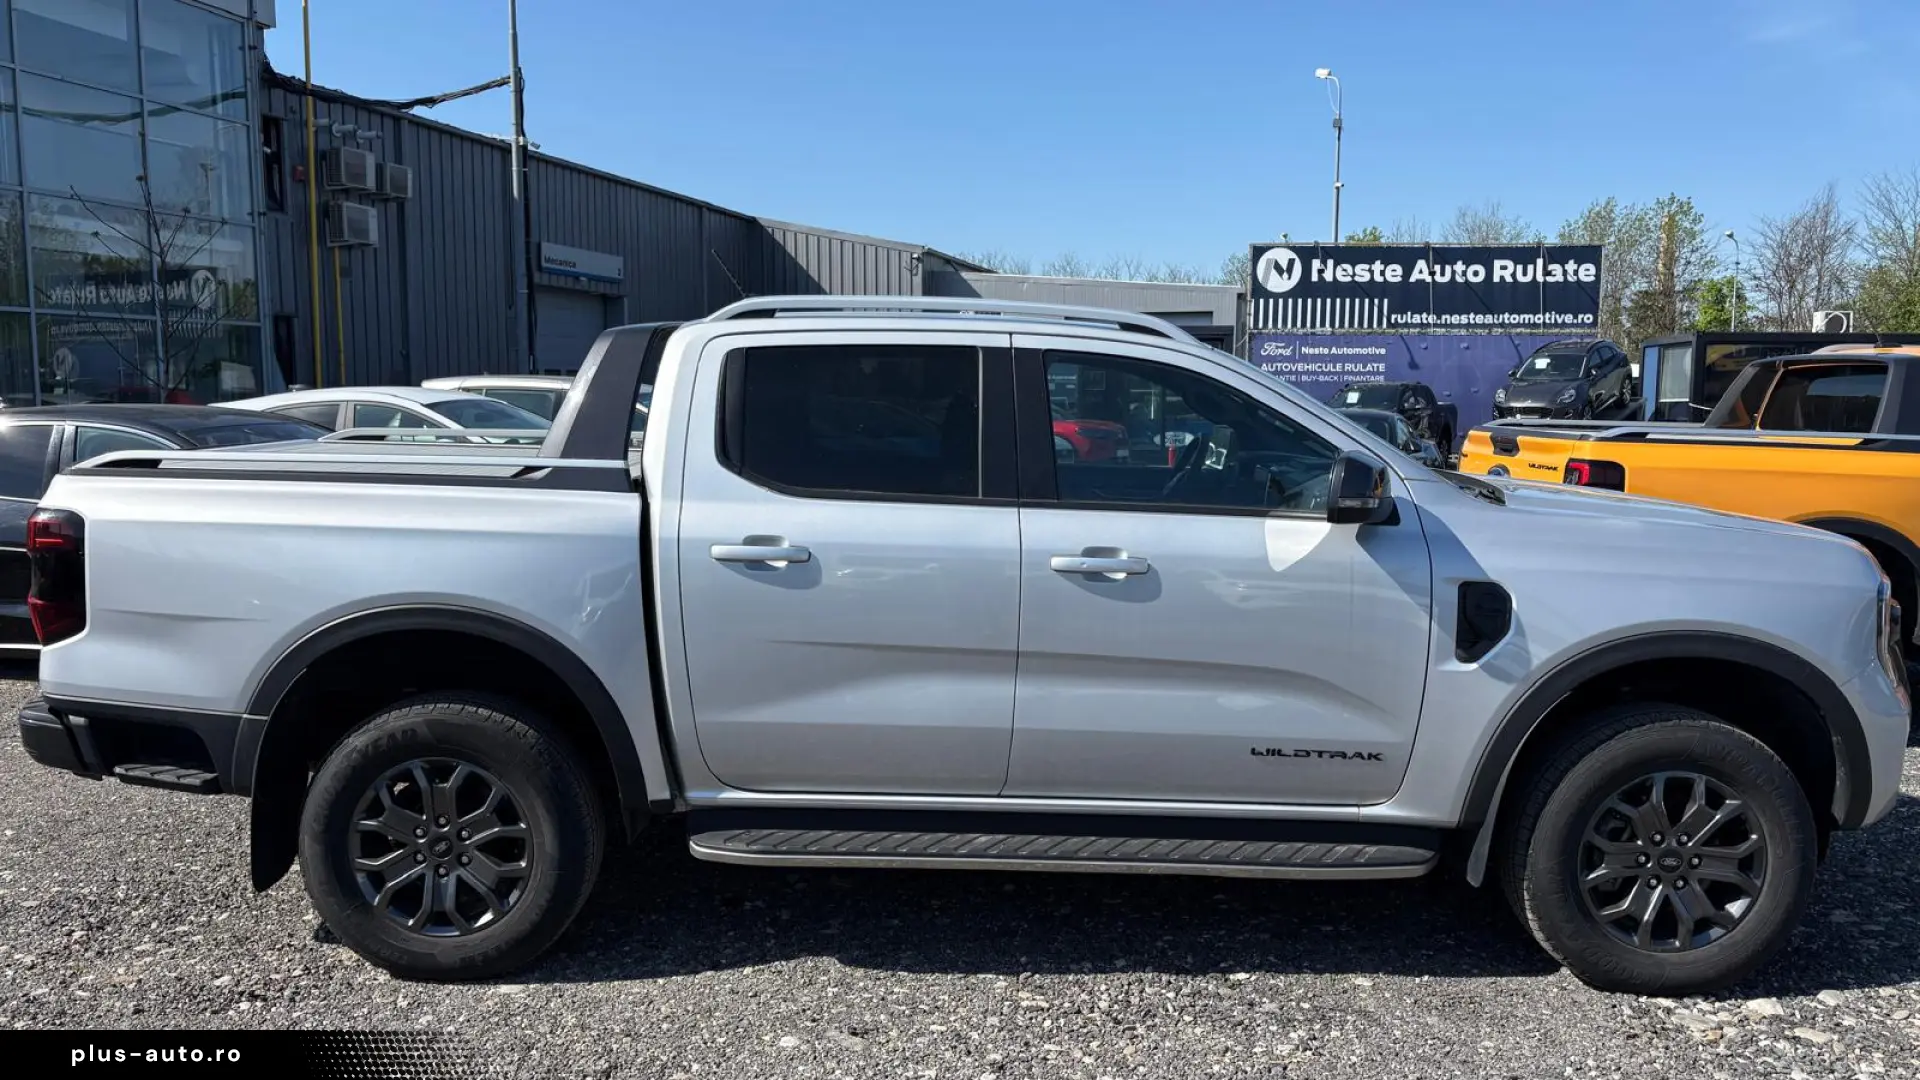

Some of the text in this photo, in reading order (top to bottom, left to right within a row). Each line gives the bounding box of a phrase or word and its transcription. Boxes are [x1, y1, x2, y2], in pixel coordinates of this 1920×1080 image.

[1311, 258, 1597, 283] Neste Auto Rulate
[1391, 311, 1594, 325] rulate.nesteautomotive.ro
[1260, 342, 1387, 356] Ford Neste Automotive
[1260, 363, 1386, 372] AUTOVEHICULE RULATE
[1250, 747, 1384, 762] WILDTRAK
